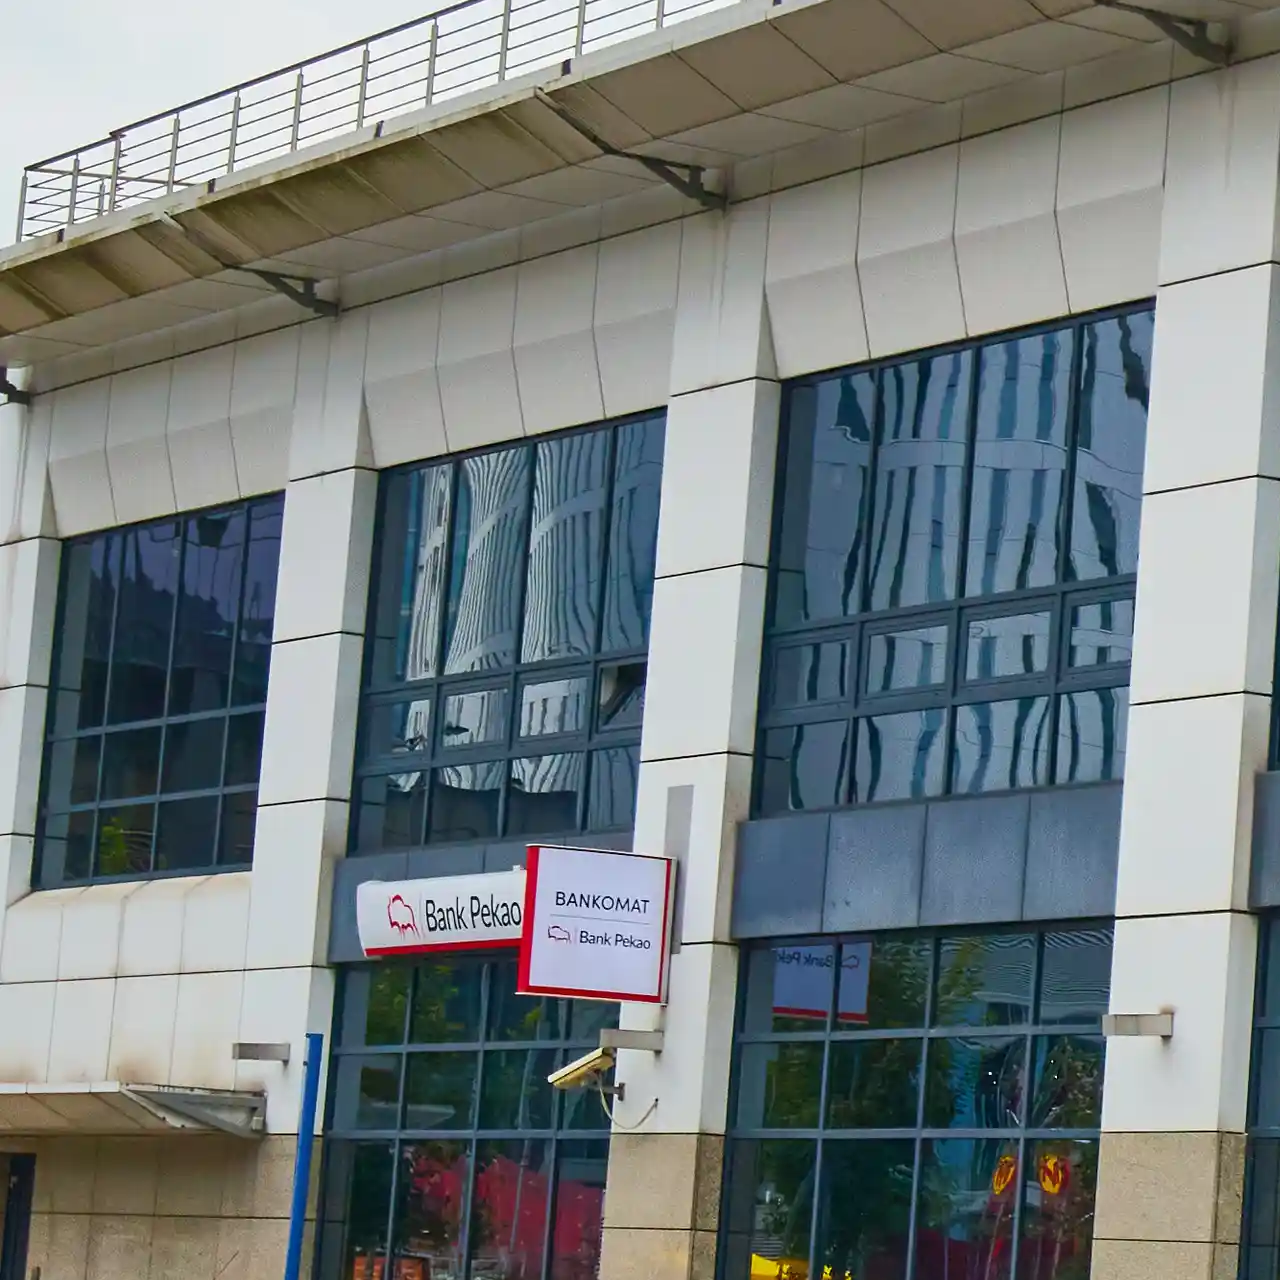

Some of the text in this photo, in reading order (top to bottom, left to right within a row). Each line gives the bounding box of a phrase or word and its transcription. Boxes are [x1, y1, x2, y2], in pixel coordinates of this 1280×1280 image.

[426, 894, 522, 932] Bank Pekao
[555, 891, 650, 914] BANKOMAT
[579, 931, 651, 949] Bank Pekao
